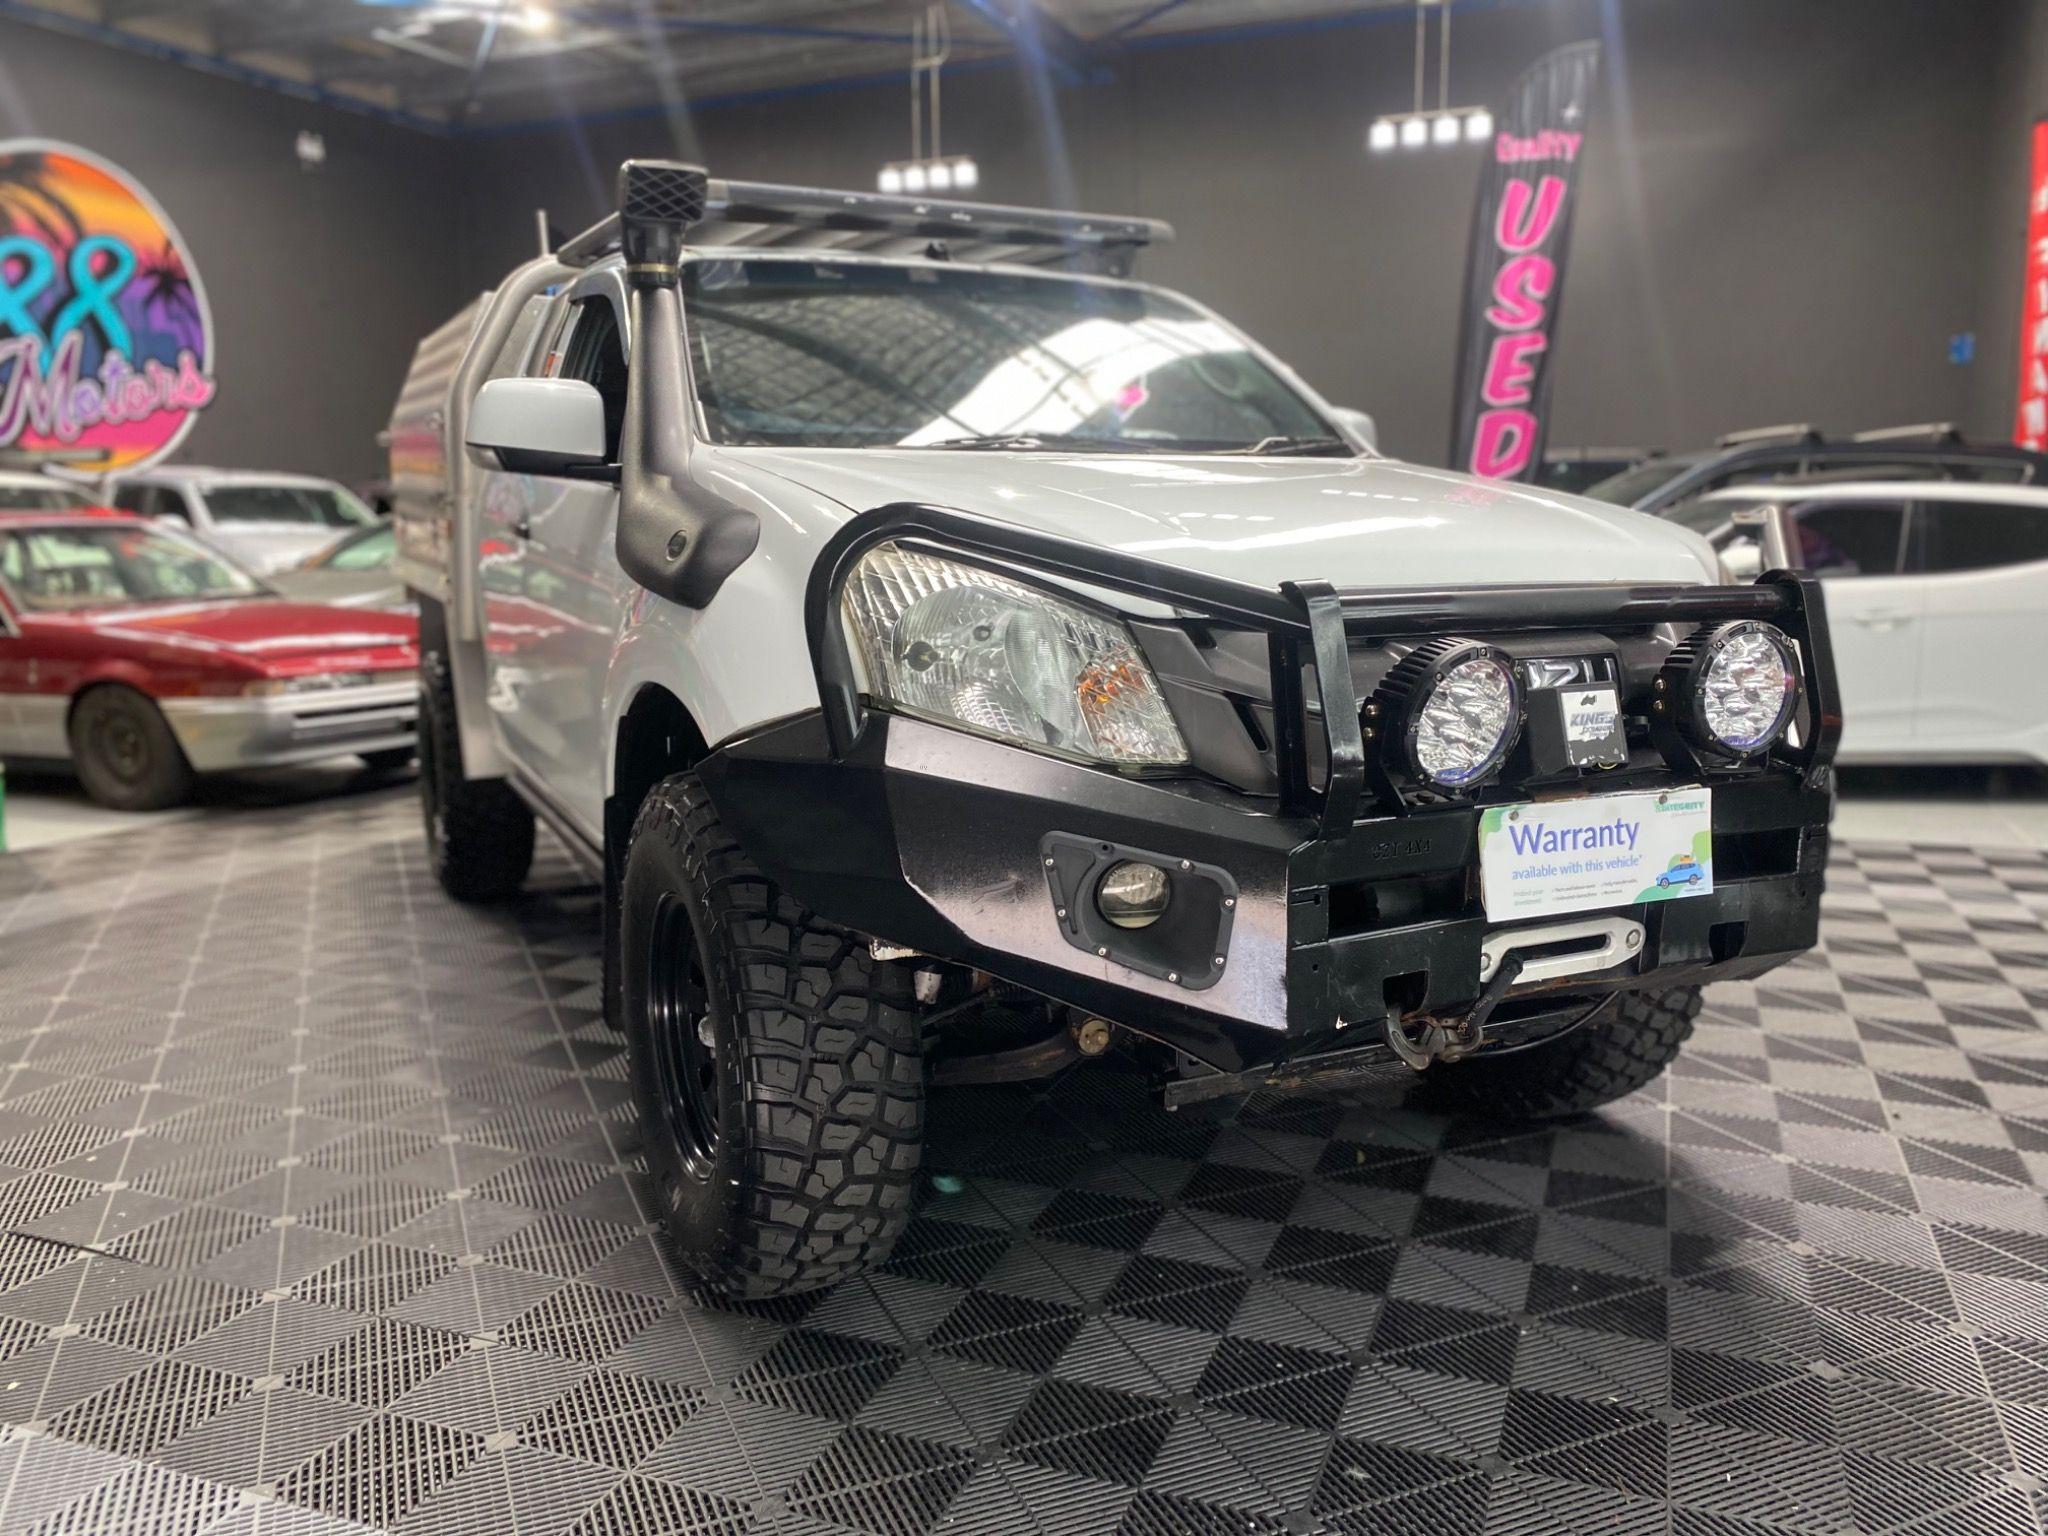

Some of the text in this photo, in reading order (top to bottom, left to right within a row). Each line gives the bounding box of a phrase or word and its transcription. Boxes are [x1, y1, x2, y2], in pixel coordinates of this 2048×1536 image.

[1471, 174, 1566, 478] USED
[0, 333, 215, 446] Motors
[1570, 711, 1615, 726] KINGS
[1508, 817, 1640, 856] Warranty
[1512, 865, 1558, 880] available
[1560, 861, 1583, 875] with
[1585, 858, 1604, 872] this
